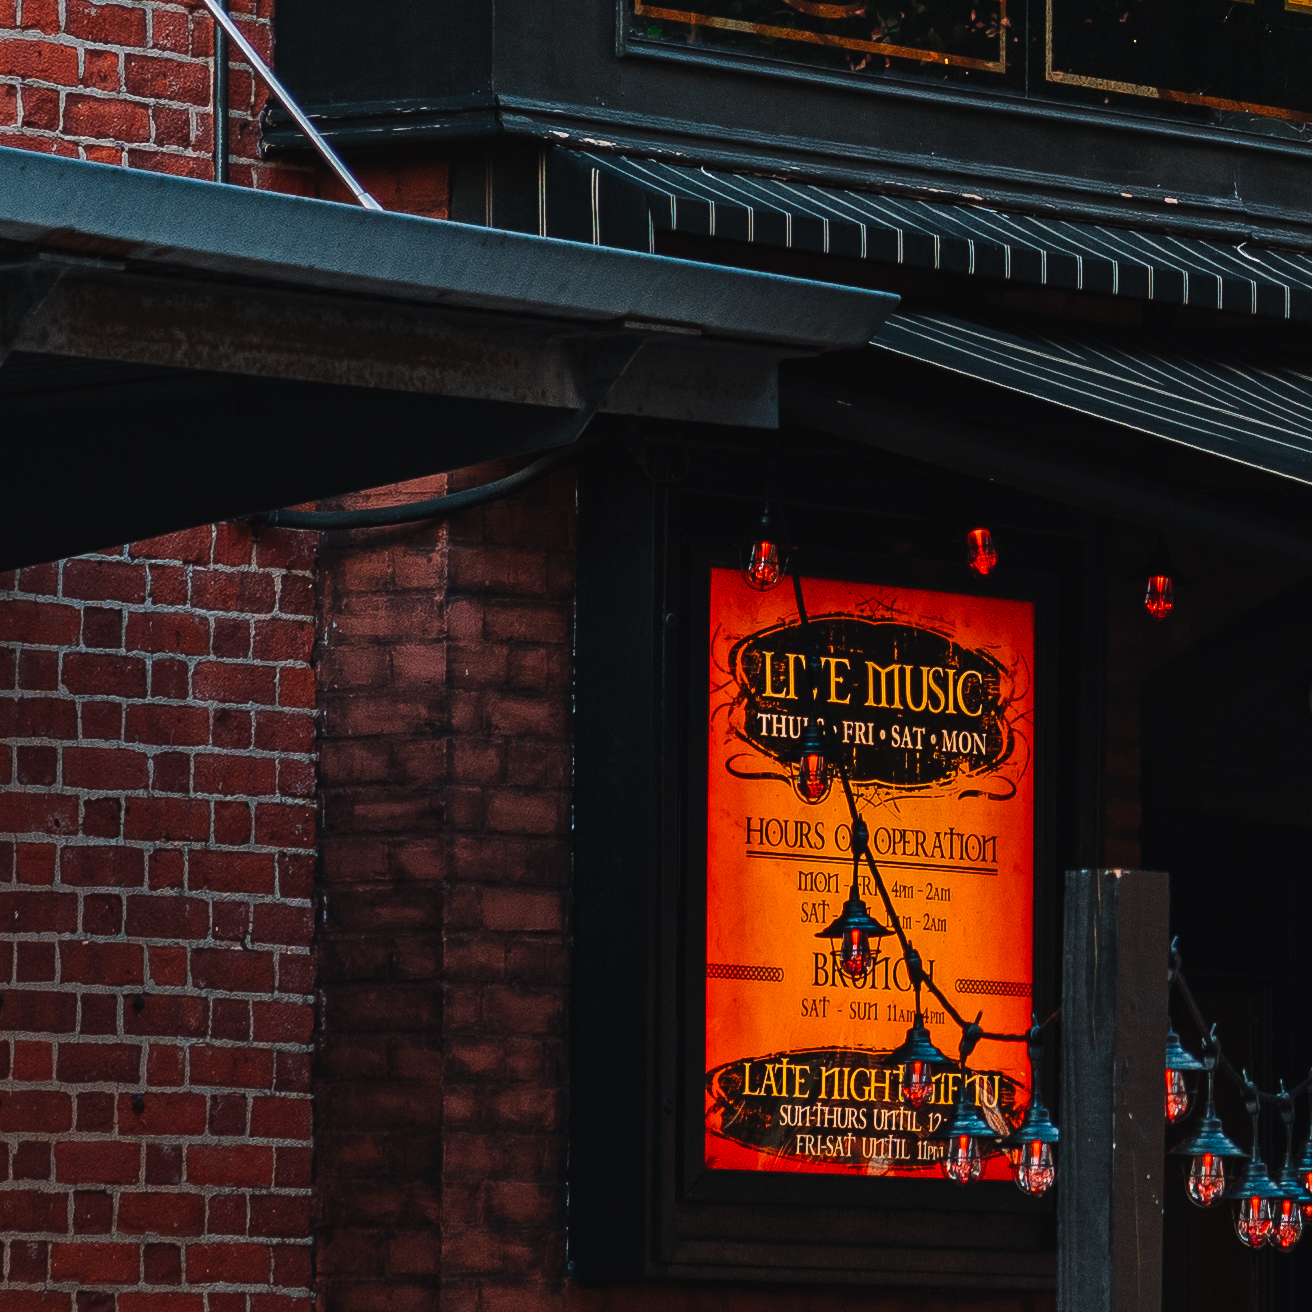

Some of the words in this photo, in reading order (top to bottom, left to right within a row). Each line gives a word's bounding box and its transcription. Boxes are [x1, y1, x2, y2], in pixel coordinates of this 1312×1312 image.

[864, 661, 982, 717] MUSIC
[757, 712, 825, 739] THU
[842, 720, 874, 746] FRI
[891, 725, 926, 750] SAT
[941, 729, 986, 755] MON
[745, 817, 825, 850] HOURS
[874, 826, 998, 863] OPERATION
[797, 870, 840, 894] MON
[801, 900, 830, 924] SAT
[801, 996, 830, 1018] SAT
[849, 1001, 878, 1021] SUN
[742, 1058, 810, 1098] LATE
[779, 1103, 867, 1130] SUN-THURS
[873, 1106, 922, 1131] UNTIL
[795, 1132, 855, 1158] FRI-SAT
[862, 1134, 911, 1160] UNTIL
